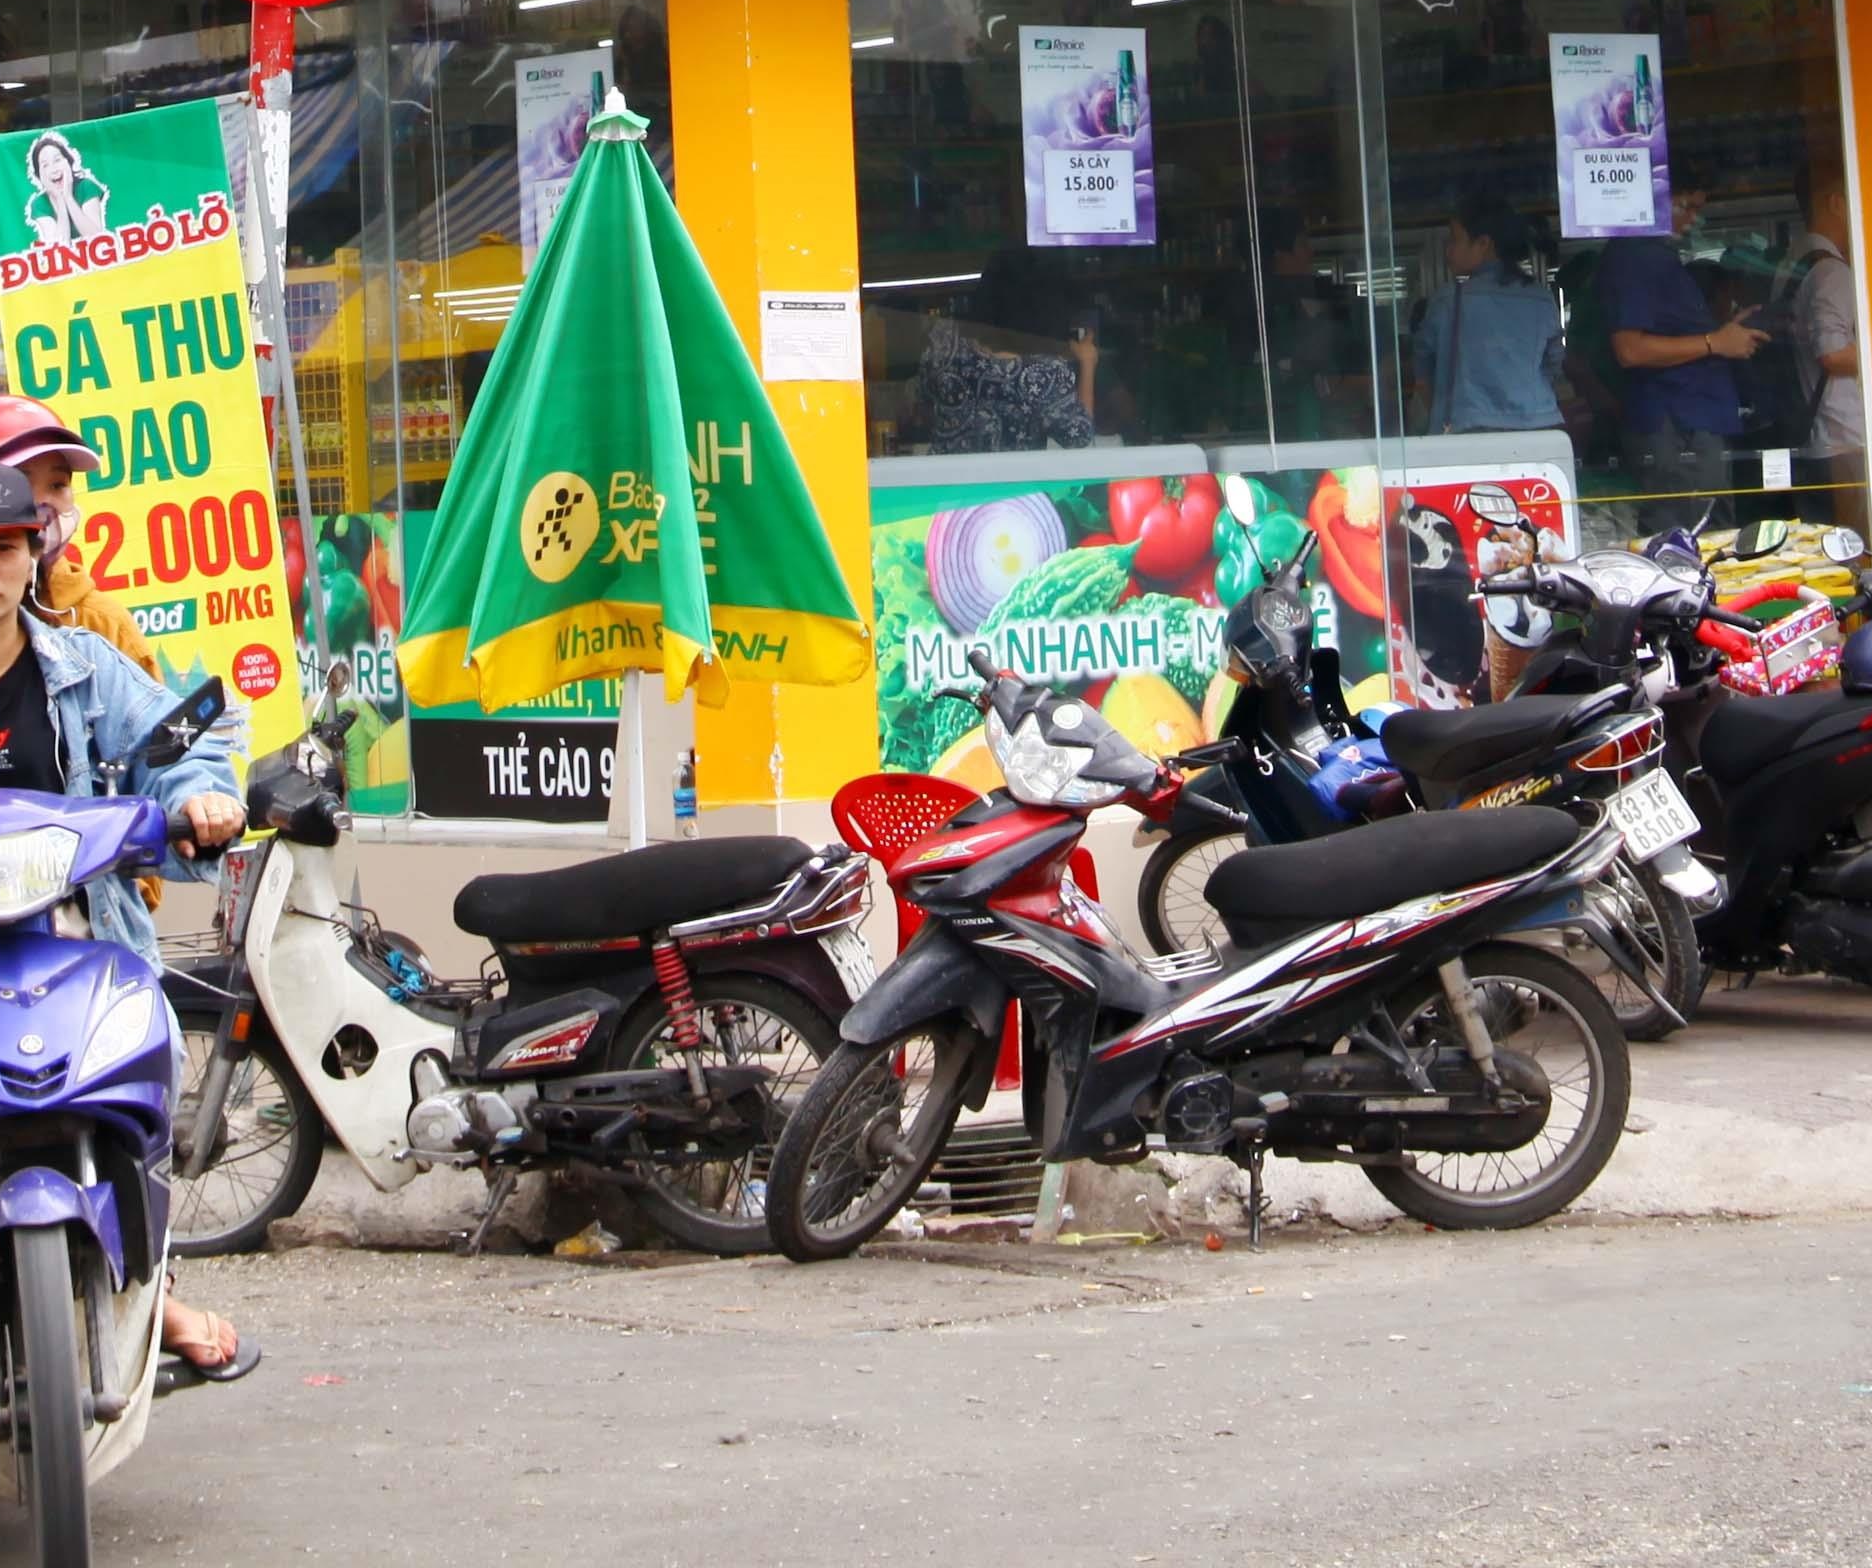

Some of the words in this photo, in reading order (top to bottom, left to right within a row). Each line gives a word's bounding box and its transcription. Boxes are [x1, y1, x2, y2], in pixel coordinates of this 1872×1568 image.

[0, 235, 119, 291] ĐỪNG
[119, 207, 176, 263] BỎ
[13, 299, 111, 402] CÁ
[122, 292, 247, 384] THU
[79, 399, 212, 494] ĐAO
[68, 489, 274, 594] 2.000
[206, 582, 276, 627] Đ/KG
[242, 652, 269, 666] 100%
[356, 632, 394, 696] RẺ
[1006, 620, 1160, 673] NHANH
[482, 732, 532, 798] THẺ
[538, 734, 588, 798] CÀO
[1632, 807, 1686, 850] 6508
[952, 916, 995, 927] HONDA
